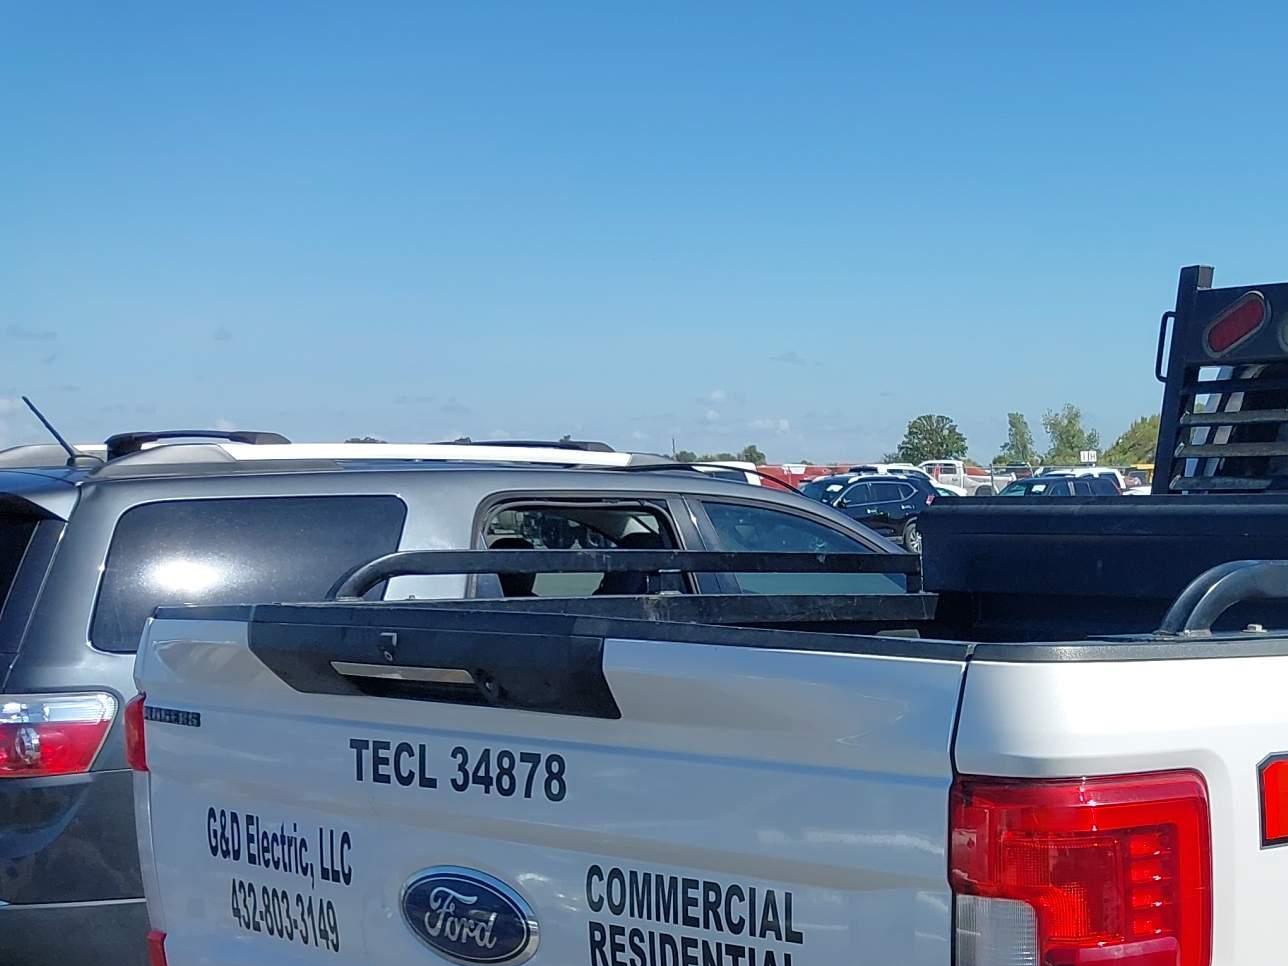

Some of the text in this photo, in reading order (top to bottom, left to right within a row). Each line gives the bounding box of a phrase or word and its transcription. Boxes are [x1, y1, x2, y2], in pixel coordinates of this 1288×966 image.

[349, 738, 567, 802] TECL 34878
[207, 807, 353, 890] G&D Electric, LLC
[232, 878, 340, 953] 432-803-3149
[425, 887, 498, 949] Ford
[586, 864, 804, 945] COMMERCIAL
